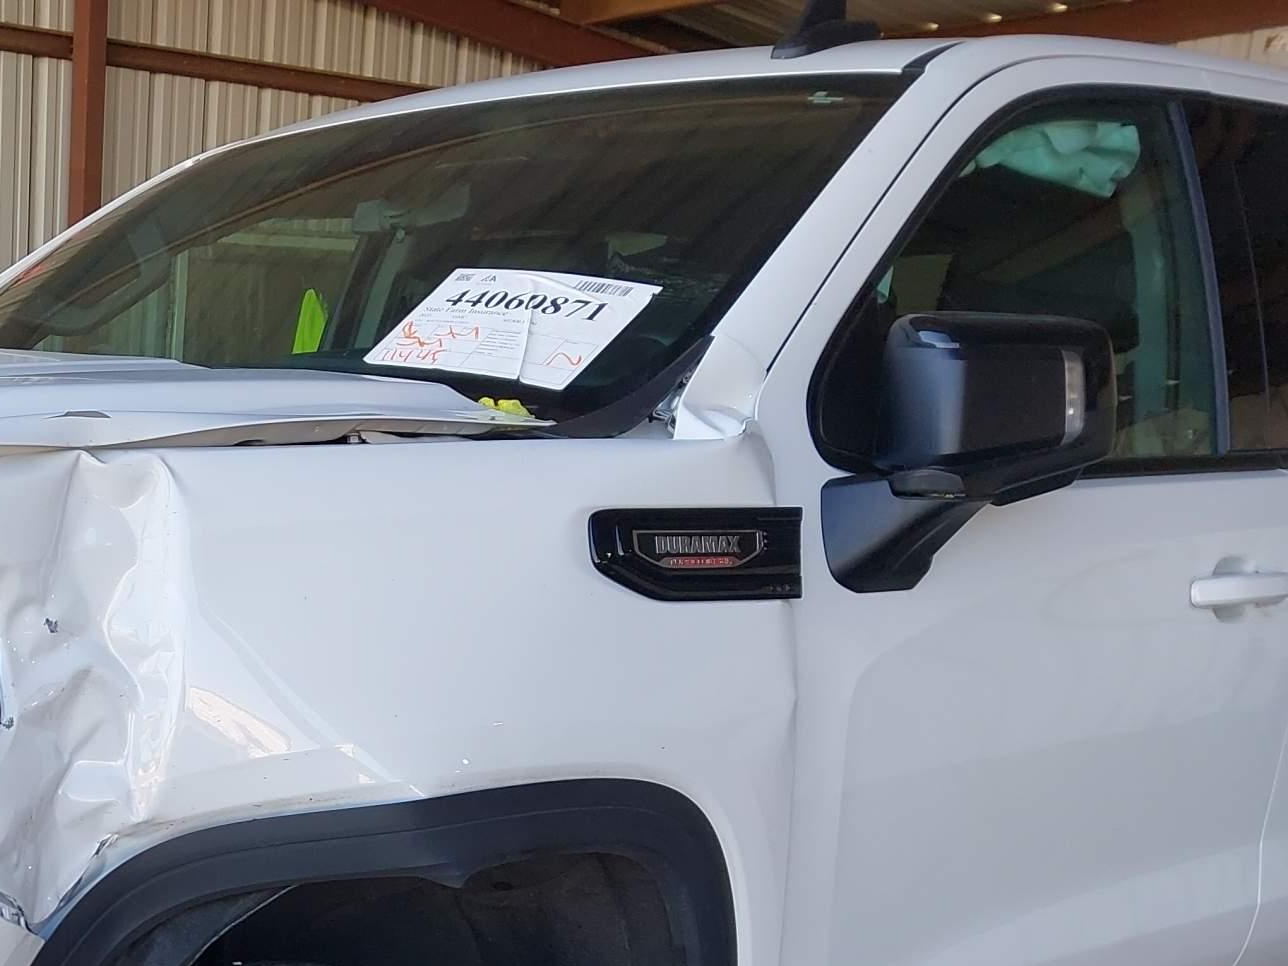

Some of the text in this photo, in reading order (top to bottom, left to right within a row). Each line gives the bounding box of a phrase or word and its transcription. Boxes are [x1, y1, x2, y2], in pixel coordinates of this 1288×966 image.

[446, 288, 609, 321] 44060871
[468, 308, 509, 317] Insurance
[655, 535, 741, 553] DURAMAX
